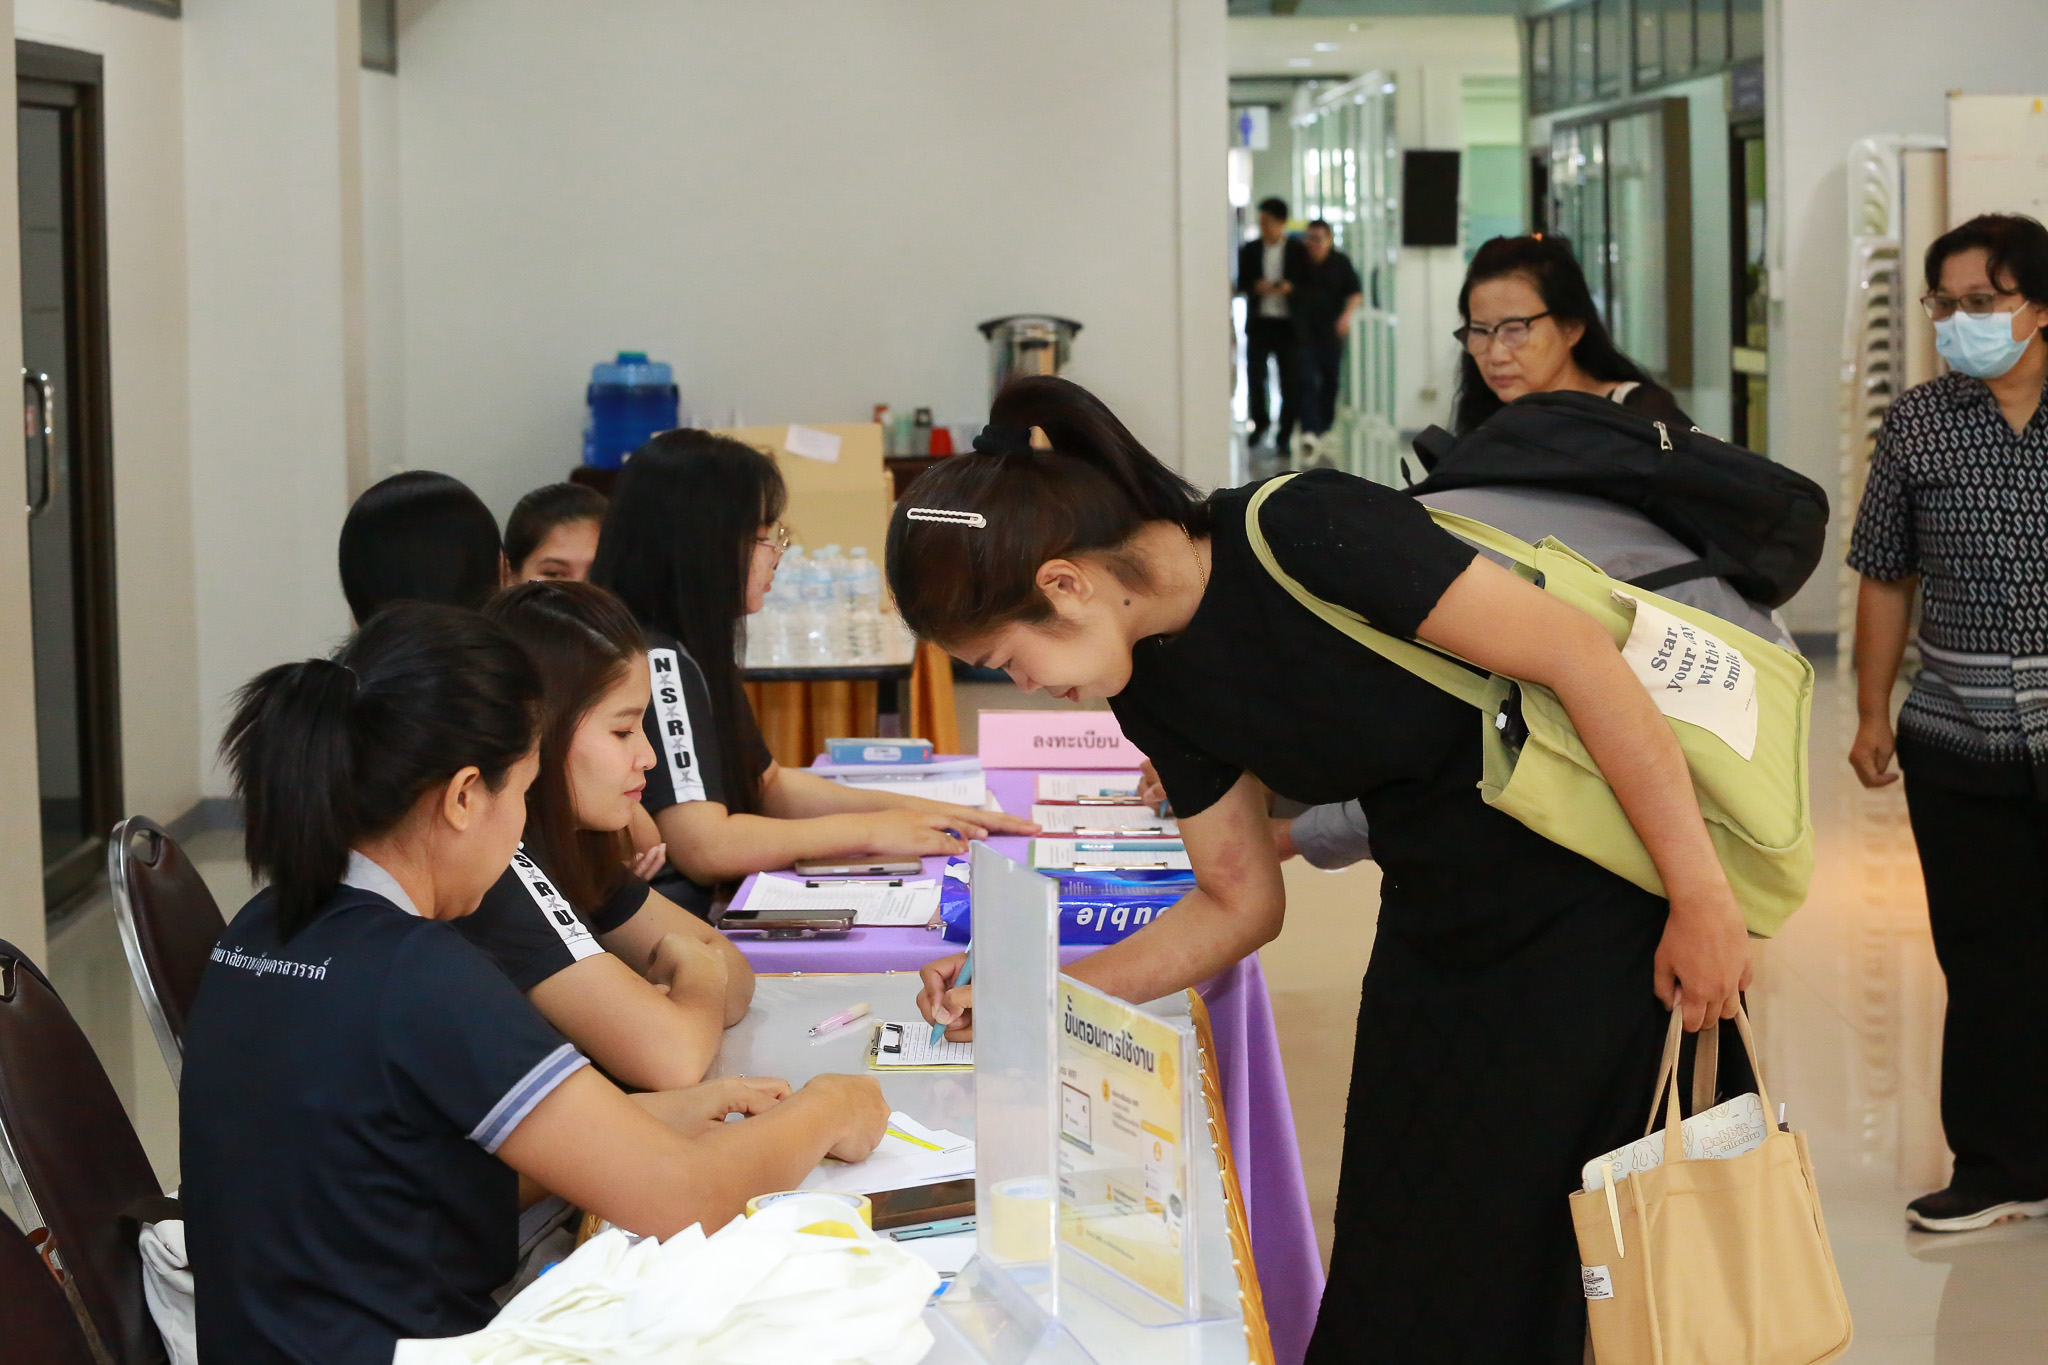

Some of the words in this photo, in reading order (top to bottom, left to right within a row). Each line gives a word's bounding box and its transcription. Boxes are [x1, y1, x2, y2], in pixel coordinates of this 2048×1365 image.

[1666, 647, 1696, 693] your
[1697, 650, 1719, 685] with
[1723, 652, 1740, 691] smile
[1033, 730, 1119, 749] ลงทะเบียน
[1064, 994, 1155, 1073] ขั้นตอนการใช้งาน
